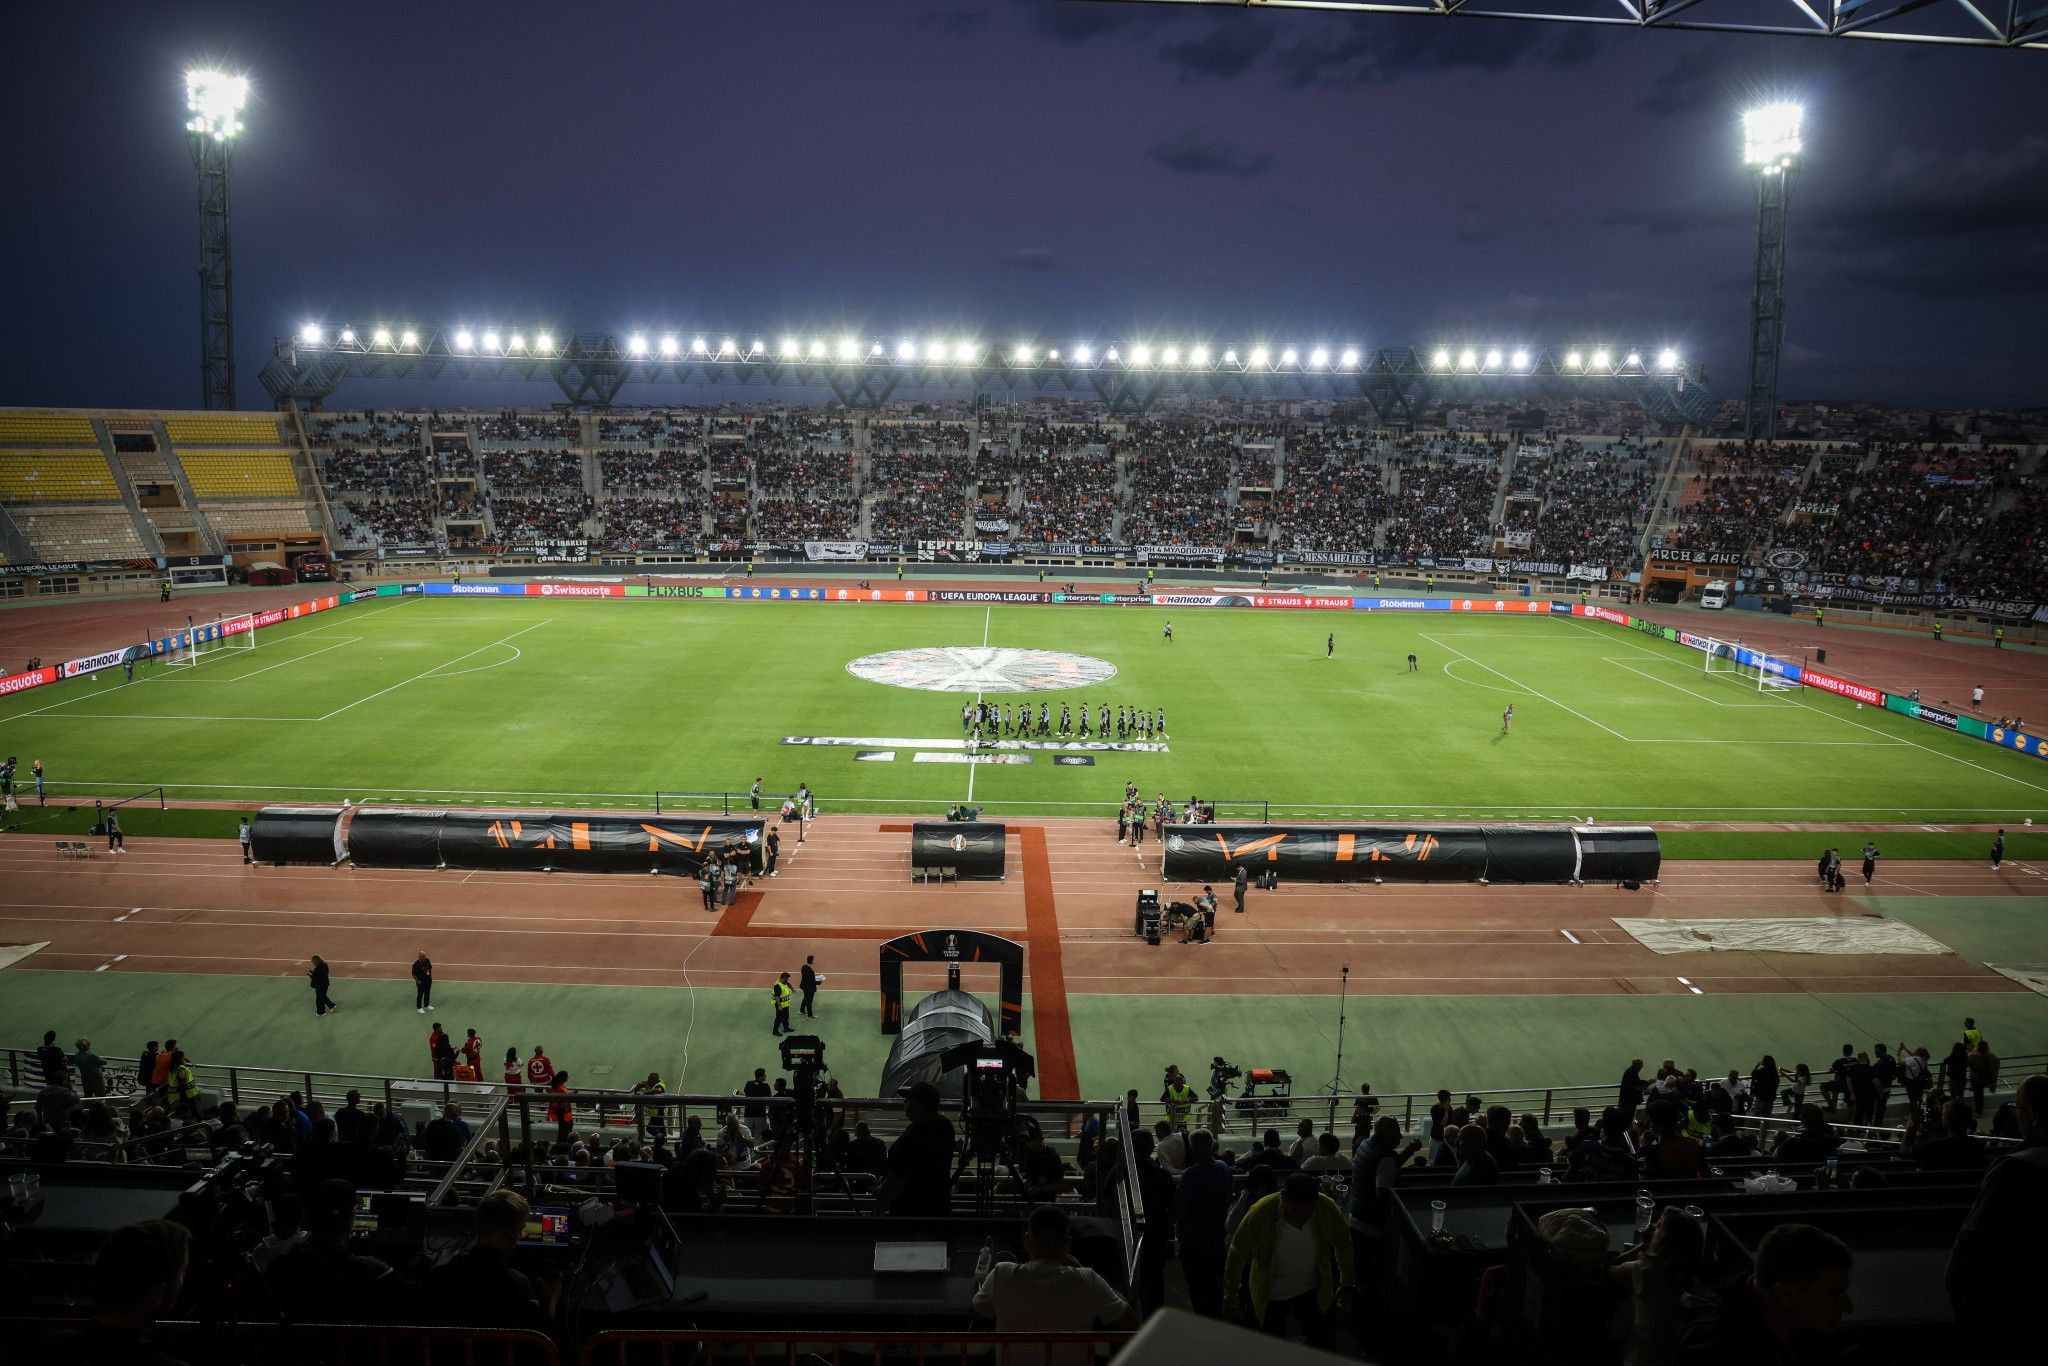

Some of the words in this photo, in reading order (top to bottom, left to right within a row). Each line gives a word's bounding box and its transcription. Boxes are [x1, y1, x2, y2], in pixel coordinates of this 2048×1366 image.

[1652, 549, 1691, 561] ARCH
[48, 562, 79, 571] LEAGUE
[554, 585, 611, 596] Swissquote
[941, 592, 965, 601] UEFA
[966, 592, 1002, 601] EUROPA
[1003, 593, 1039, 602] LEAGUE
[1057, 594, 1101, 602] enterprise
[1106, 595, 1151, 603] enterprise
[1268, 598, 1302, 606] STRAUSS
[1315, 599, 1349, 607] STRAUSS
[259, 610, 282, 625] STRAUSS
[1808, 673, 1838, 690] STRAUSS
[1845, 685, 1877, 702] STRAUSS
[1913, 706, 1958, 725] enterprise
